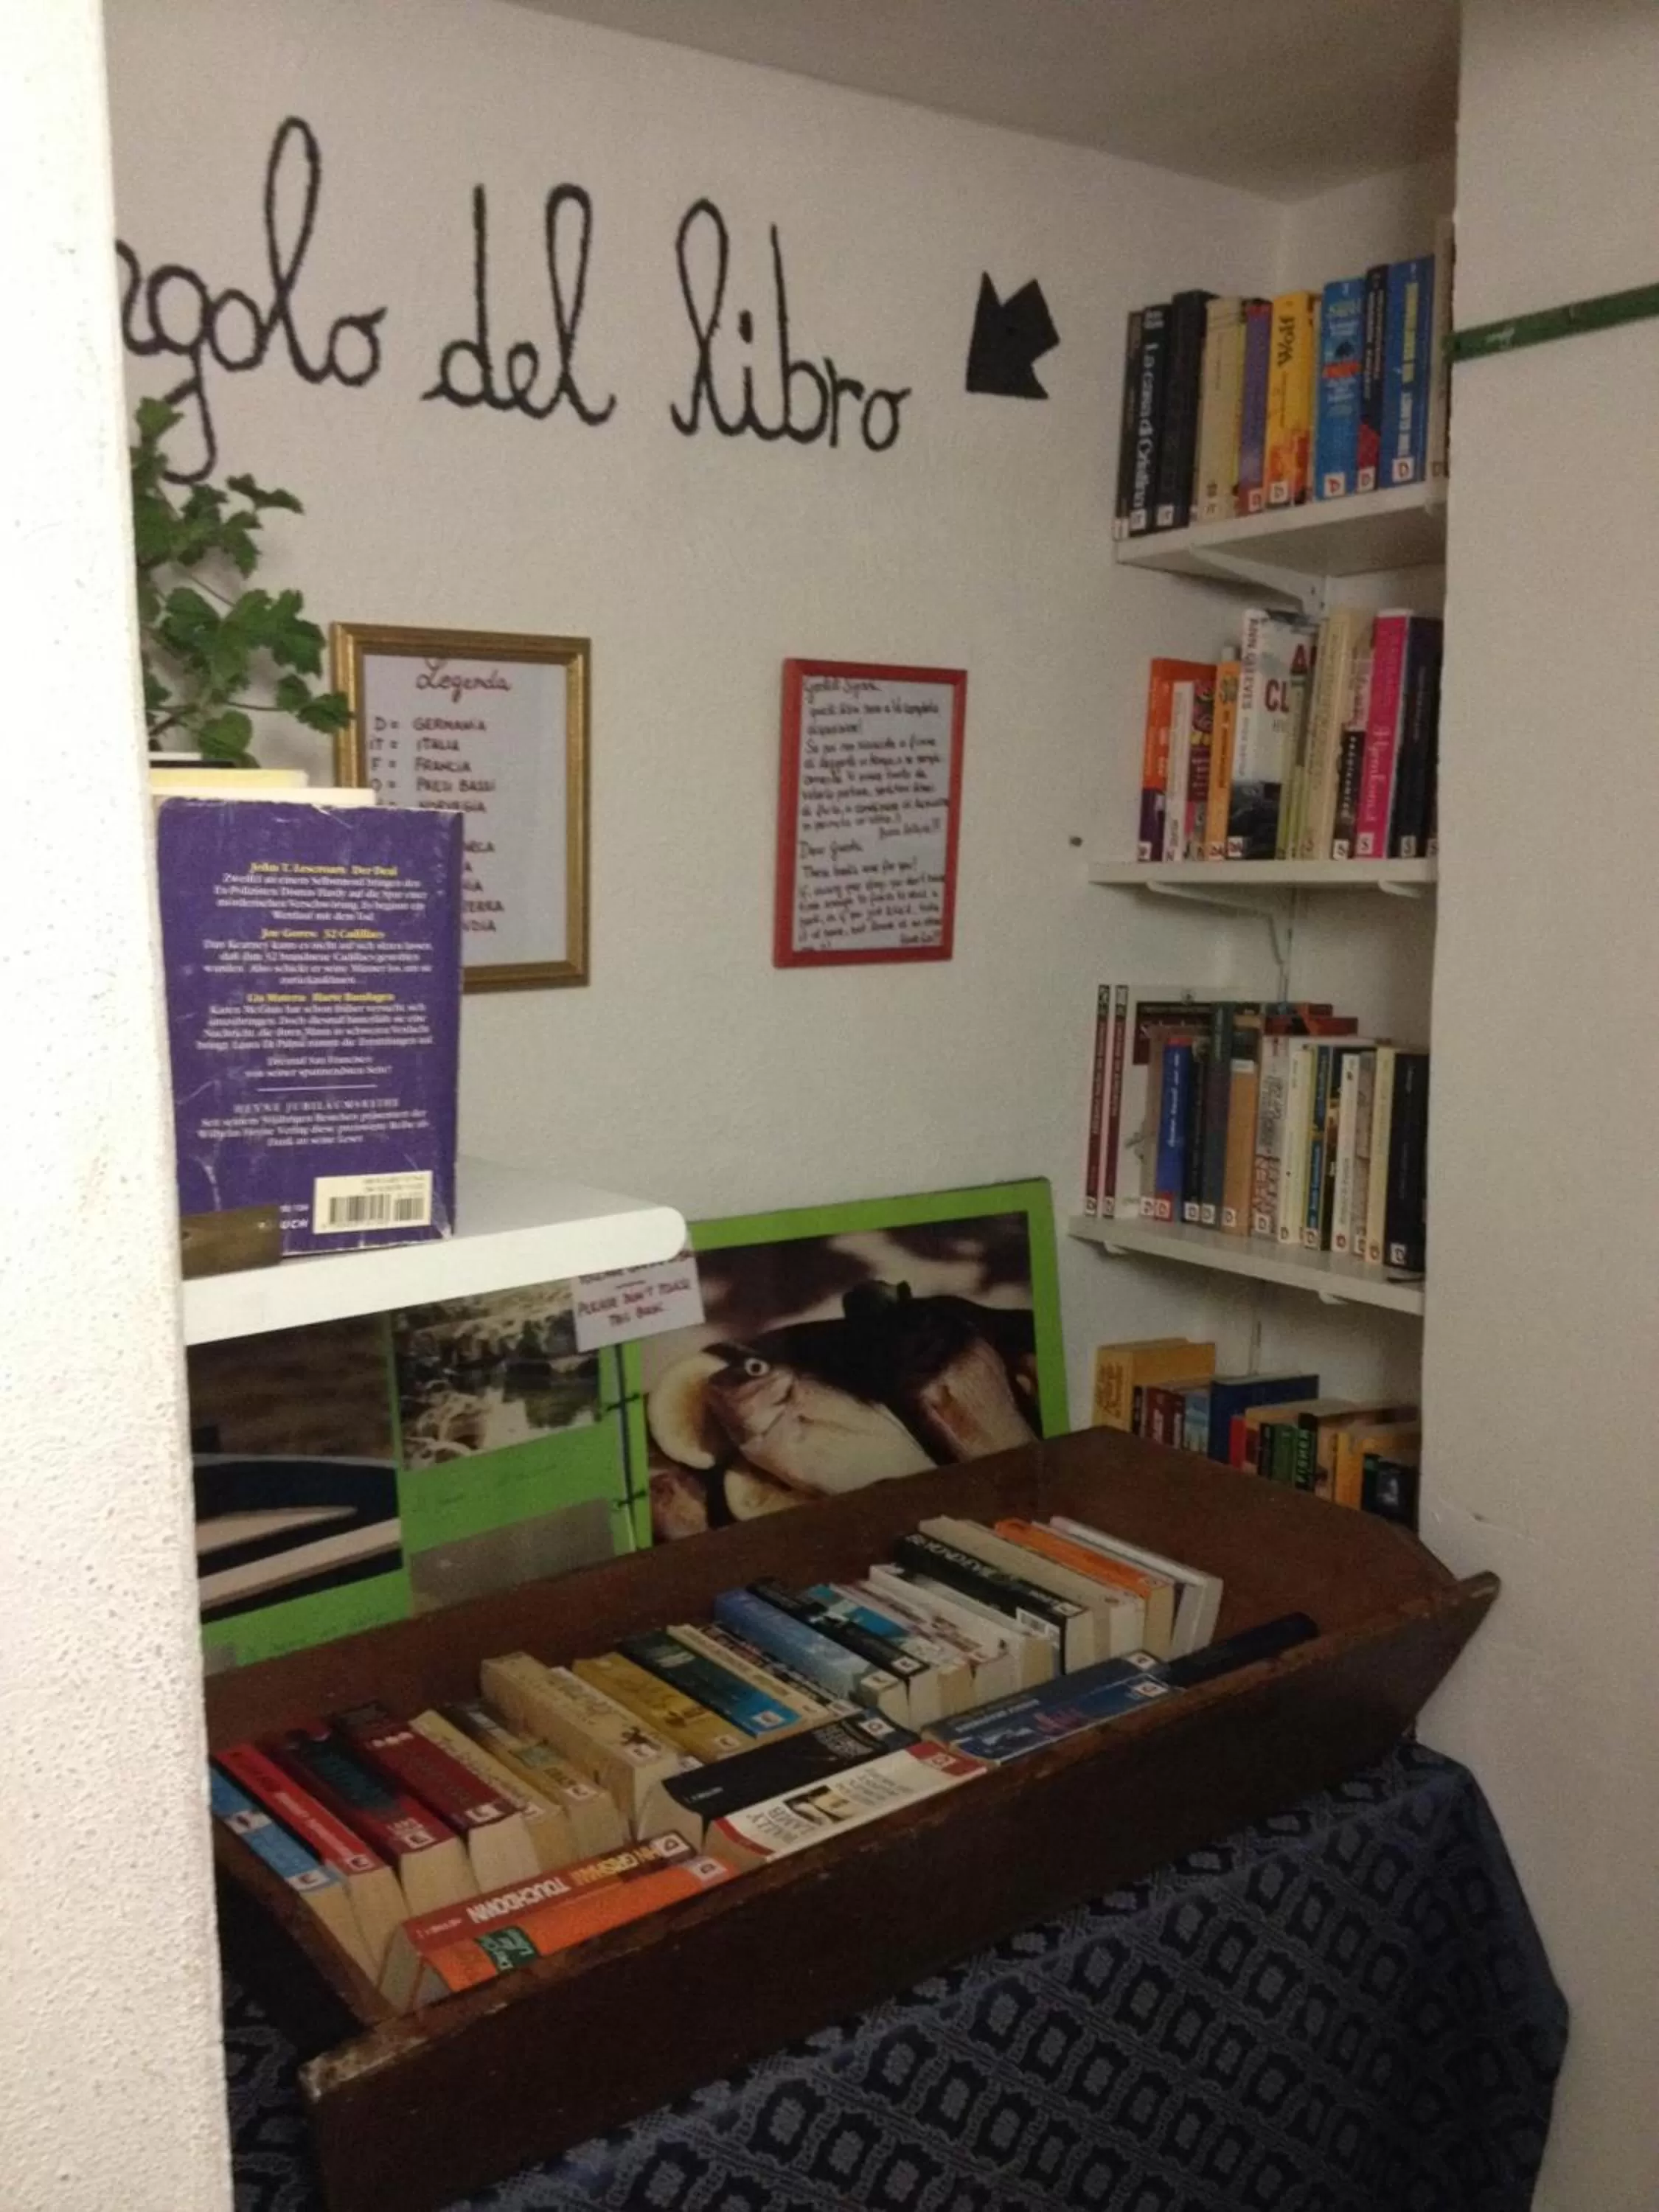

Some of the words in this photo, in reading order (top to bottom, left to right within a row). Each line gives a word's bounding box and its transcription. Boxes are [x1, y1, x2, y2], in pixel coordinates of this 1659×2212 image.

[420, 184, 616, 425] del
[669, 198, 914, 452] libro
[417, 655, 511, 703] Legenda
[466, 1876, 572, 1924] TOUCHDOWN
